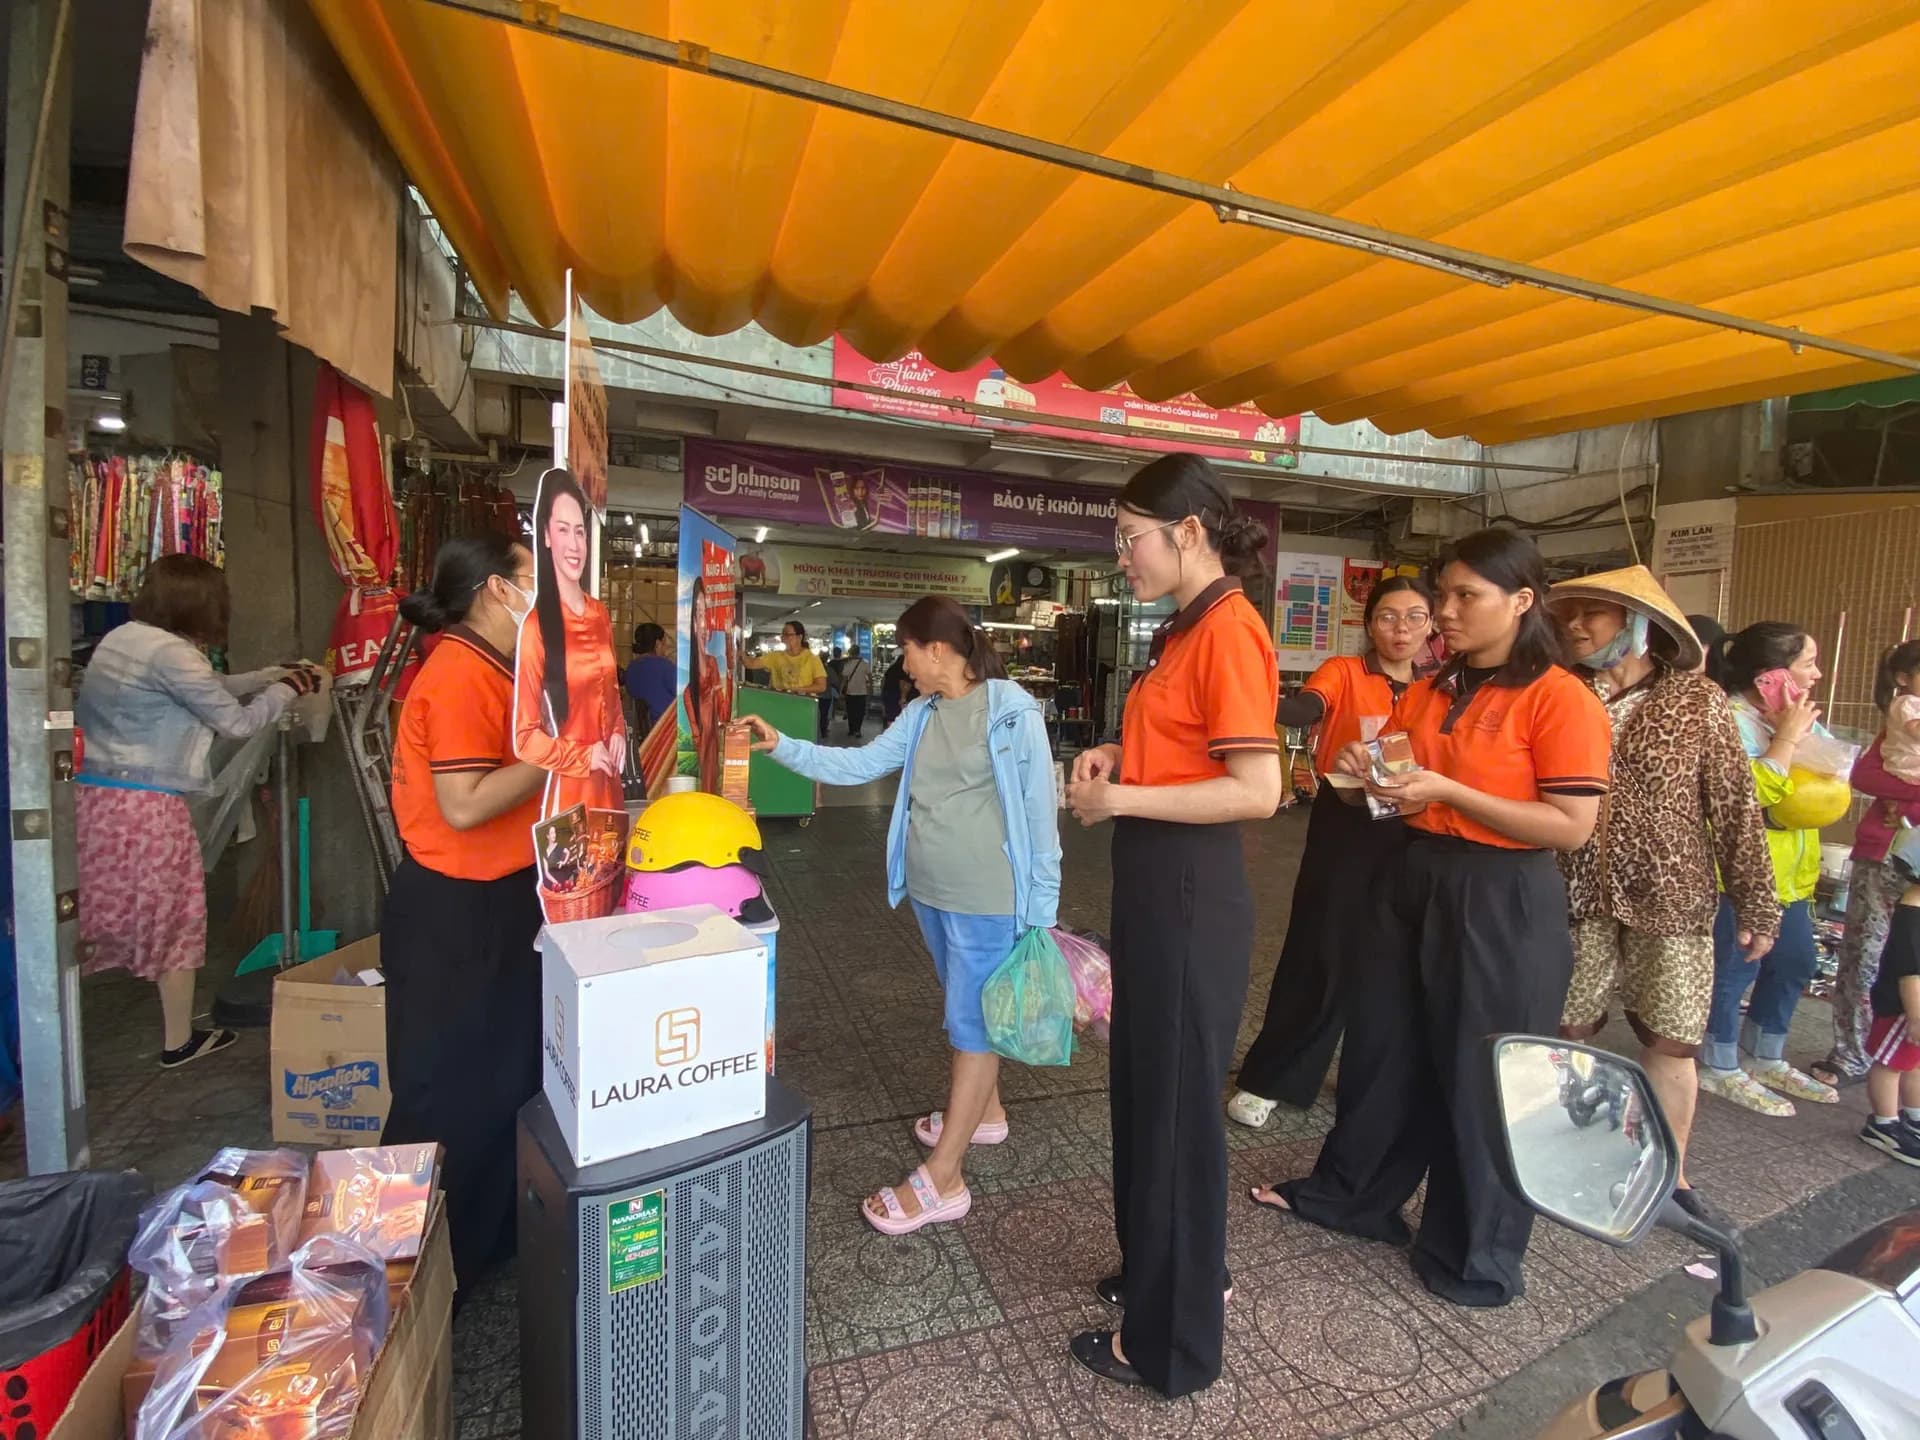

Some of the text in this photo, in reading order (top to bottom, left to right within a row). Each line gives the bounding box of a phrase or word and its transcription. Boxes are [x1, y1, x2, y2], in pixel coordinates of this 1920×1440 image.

[743, 488, 767, 499] Family
[768, 491, 799, 503] Company
[993, 489, 1023, 509] BẢO
[1026, 494, 1045, 516] VỆ
[1047, 496, 1083, 515] KHỎI
[1671, 526, 1713, 538] KIM LAN
[291, 1064, 371, 1100] Alpenliebe
[592, 1052, 758, 1109] LAURA COFFEE
[612, 1206, 659, 1226] NANOMAX
